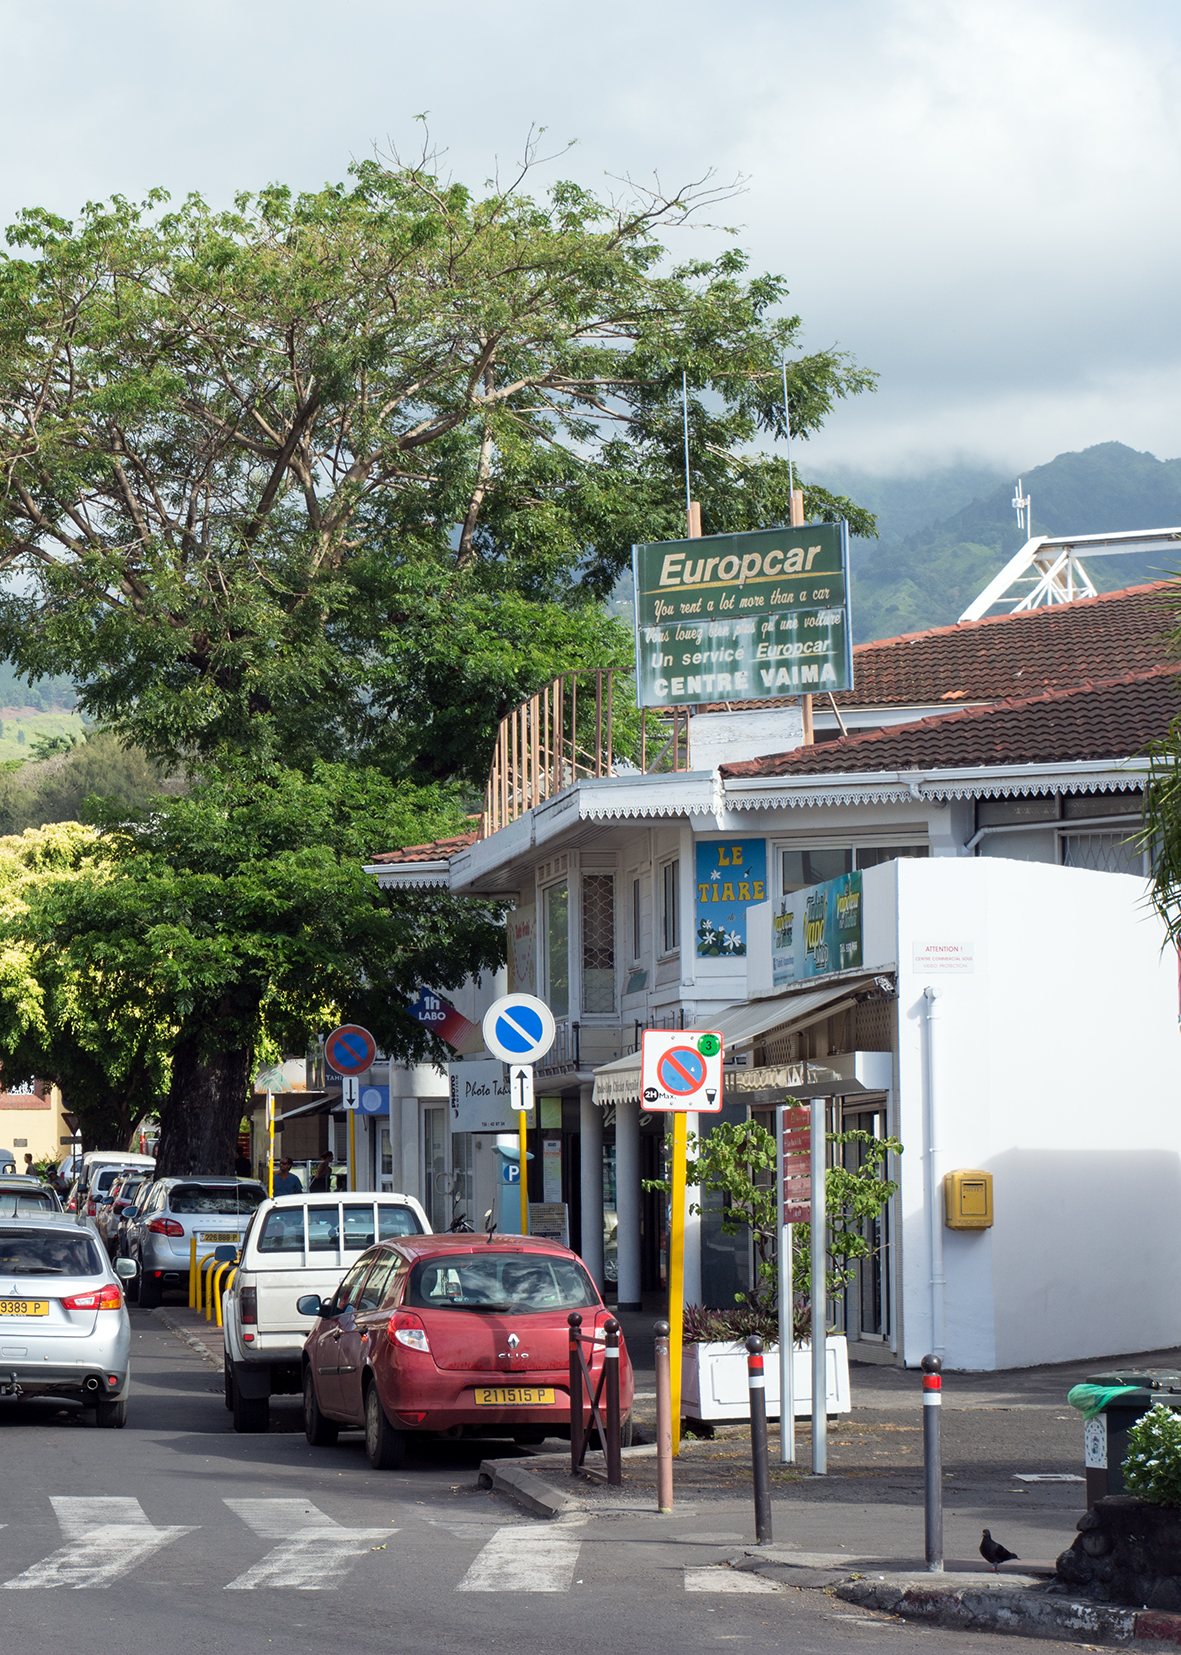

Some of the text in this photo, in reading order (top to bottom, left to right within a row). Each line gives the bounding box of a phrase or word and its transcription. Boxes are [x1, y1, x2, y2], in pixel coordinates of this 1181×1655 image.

[658, 545, 822, 586] Europcar
[654, 587, 830, 624] You rent a lot more than a car
[644, 626, 670, 644] Vous
[675, 623, 703, 646] louez
[709, 620, 729, 638] bien
[733, 619, 756, 641] plus
[804, 612, 841, 629] voiture
[651, 638, 831, 669] Un service Europcar
[653, 663, 837, 697] CENTRE VAIMA
[717, 846, 744, 867] LE
[698, 881, 765, 903] TIARE
[424, 997, 439, 1010] 1h
[419, 1012, 446, 1020] LABO
[705, 1041, 712, 1050] 3
[465, 1081, 491, 1098] Photo
[509, 1165, 520, 1182] P
[34, 1303, 41, 1313] P
[483, 1389, 545, 1402] 211515 P
